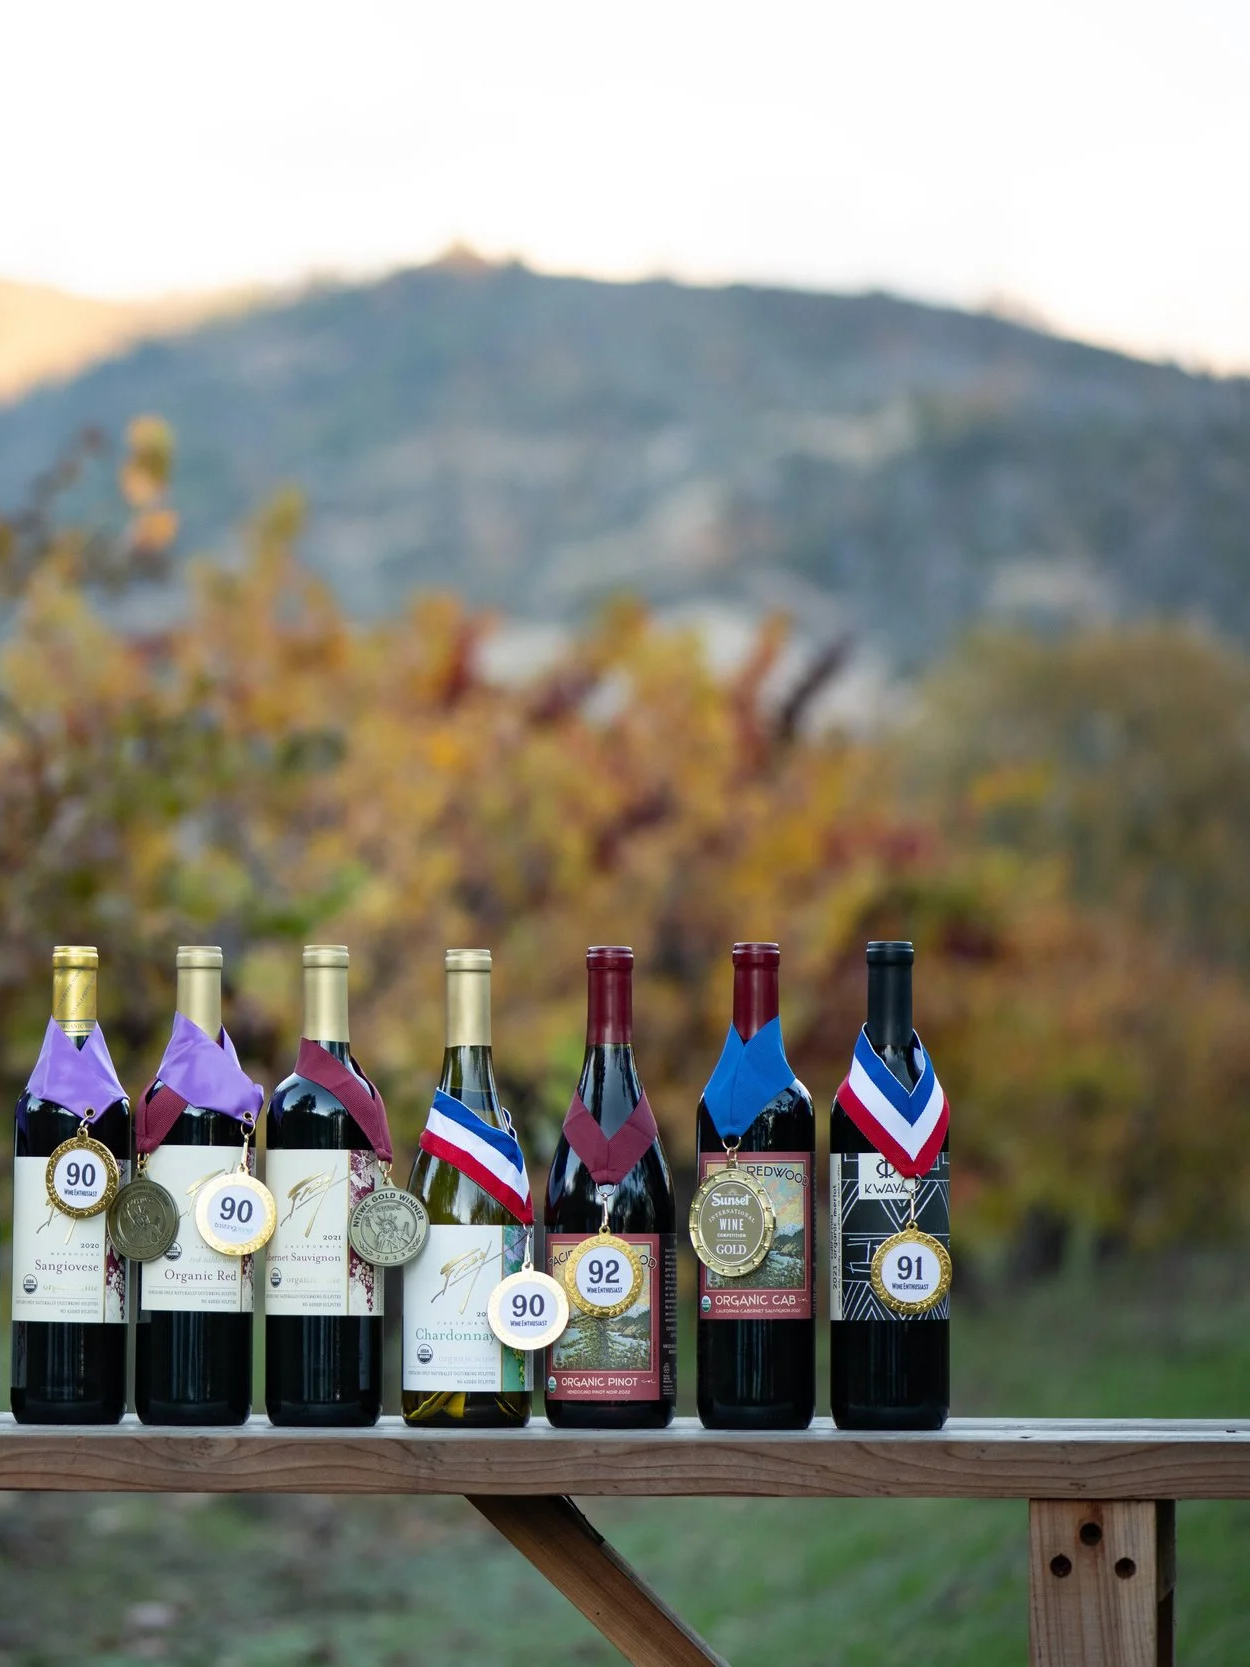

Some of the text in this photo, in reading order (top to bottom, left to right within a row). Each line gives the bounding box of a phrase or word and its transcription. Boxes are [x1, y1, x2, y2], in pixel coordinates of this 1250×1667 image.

[66, 1162, 96, 1187] 90
[746, 1166, 810, 1187] REDWOOD
[711, 1193, 752, 1207] Sunset
[220, 1197, 253, 1223] 90
[353, 1192, 425, 1228] NYIWC GOLD WINNER
[709, 1209, 755, 1223] INTERNATIONAL
[719, 1218, 744, 1230] WINE
[716, 1244, 747, 1255] GOLD
[291, 1252, 341, 1265] Sauvignon
[35, 1259, 99, 1275] Sangiovese
[588, 1260, 619, 1284] 92
[897, 1256, 923, 1280] 91
[164, 1269, 237, 1283] Organic Red
[512, 1294, 545, 1317] 90
[715, 1294, 796, 1307] ORGANIC CAB
[415, 1327, 496, 1345] Chardonnay
[561, 1376, 638, 1387] ORGANIC PINOT
